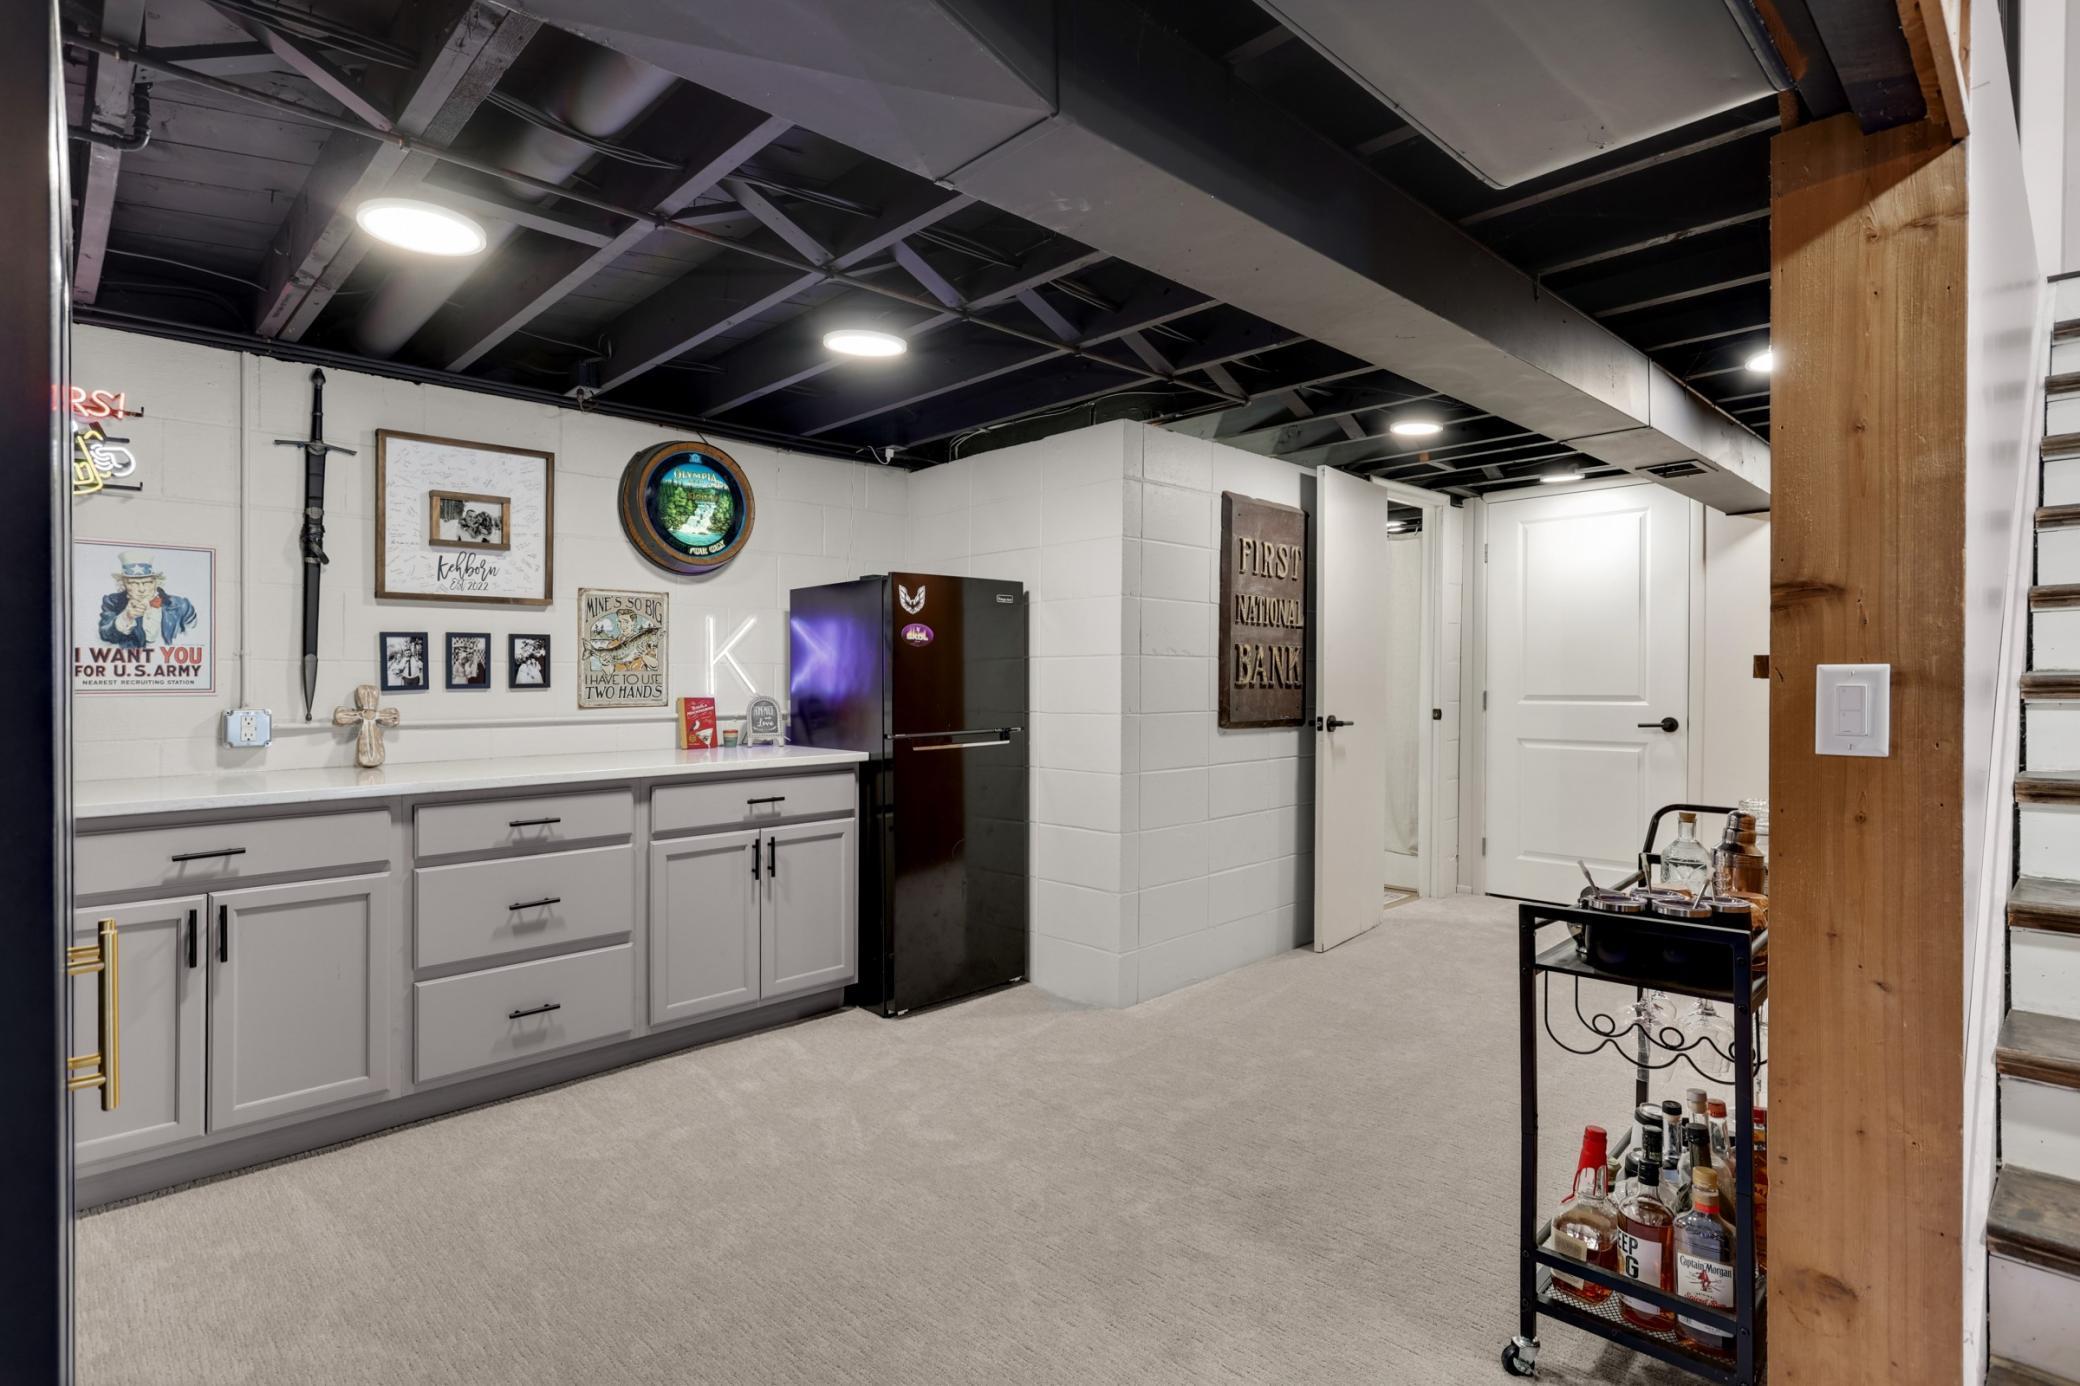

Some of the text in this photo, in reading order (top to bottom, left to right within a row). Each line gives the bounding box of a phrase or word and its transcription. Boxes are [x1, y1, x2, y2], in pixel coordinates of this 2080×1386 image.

[673, 470, 717, 481] OLYMPIA
[1239, 537, 1302, 581] FIRST
[586, 595, 662, 625] MINE'S SO BIG
[1235, 594, 1304, 629] NATIONAL
[75, 646, 203, 664] I WANT YOU
[706, 615, 757, 695] K
[1234, 643, 1302, 689] BANK
[75, 665, 106, 677] FOR
[590, 674, 620, 685] HAVE
[622, 674, 639, 685] TO
[642, 673, 662, 685] USE
[585, 685, 662, 699] TWO HANDS
[1679, 1255, 1732, 1278] Captain Morgan
